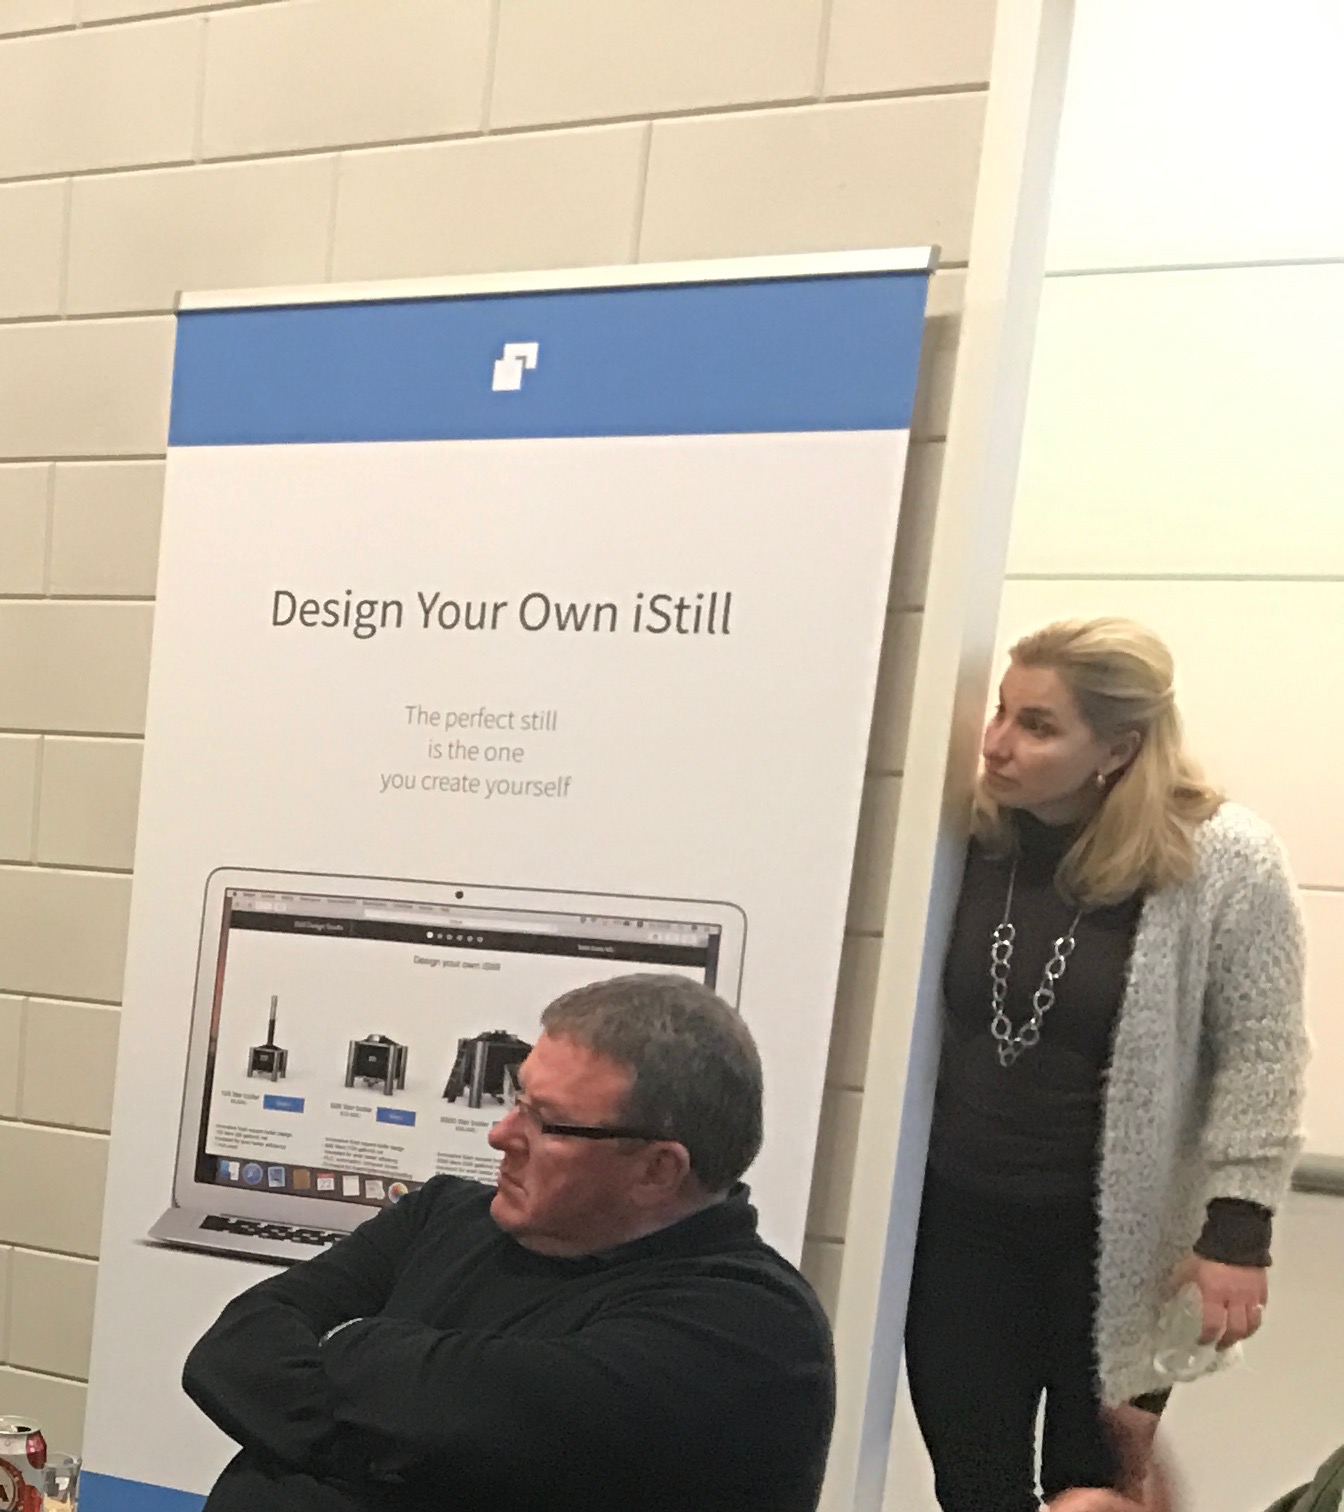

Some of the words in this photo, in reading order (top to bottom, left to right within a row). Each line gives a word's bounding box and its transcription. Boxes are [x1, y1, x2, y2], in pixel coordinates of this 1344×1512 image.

[271, 589, 404, 640] Design
[416, 591, 508, 631] Your
[518, 592, 618, 632] Own
[632, 591, 733, 635] iStill
[405, 705, 441, 727] The
[444, 706, 515, 733] perfect
[520, 709, 559, 732] still
[427, 740, 443, 760] is
[447, 740, 480, 761] the
[483, 745, 525, 764] one
[379, 772, 416, 794] you
[421, 773, 481, 794] create
[484, 775, 573, 799] yourself
